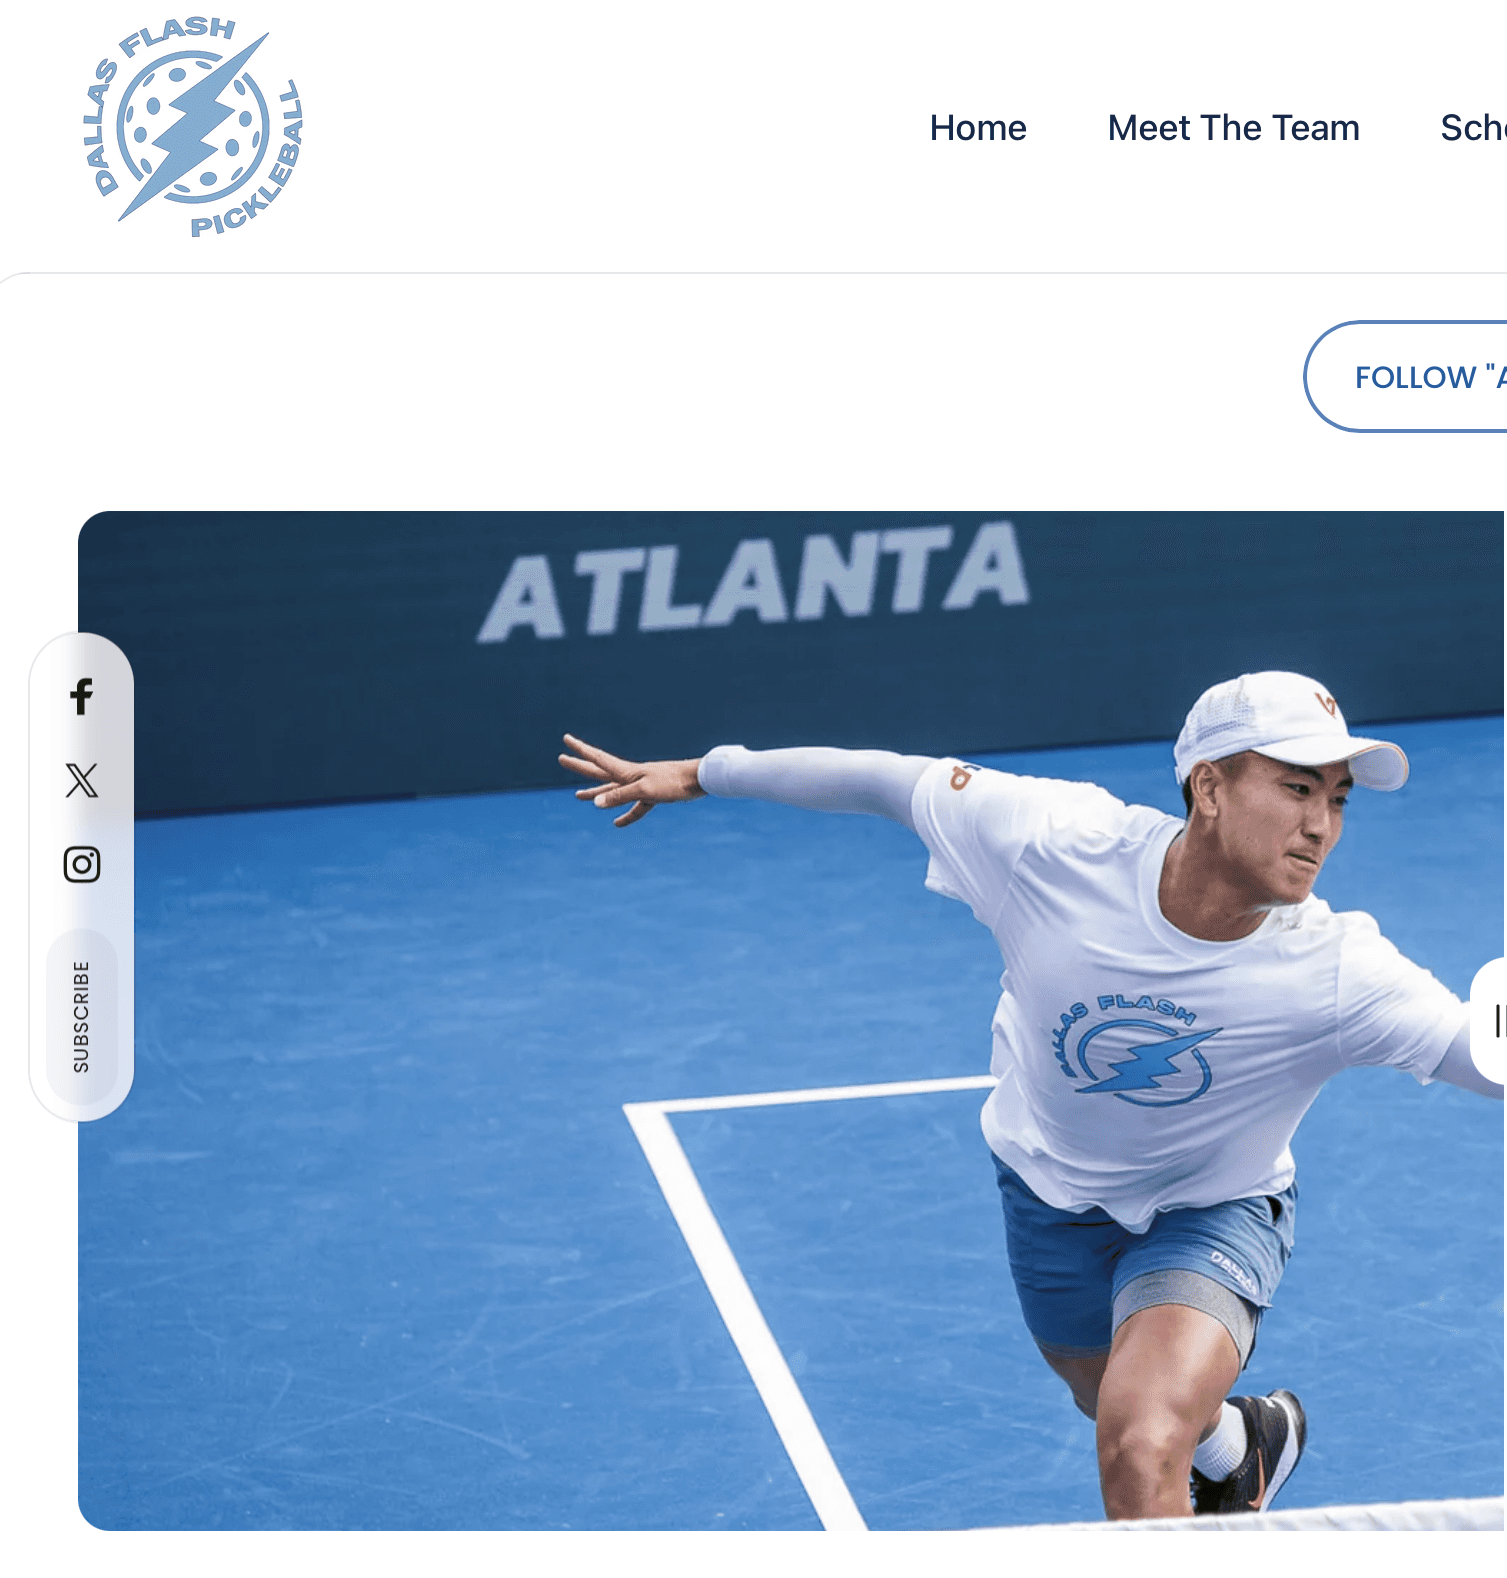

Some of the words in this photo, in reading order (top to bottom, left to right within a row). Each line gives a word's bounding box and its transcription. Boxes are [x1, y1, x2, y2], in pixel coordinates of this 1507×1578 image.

[83, 58, 119, 197] DALLAS
[118, 16, 236, 58] FLASH
[932, 114, 1026, 141] Home
[1110, 114, 1190, 141] Meet
[1200, 113, 1261, 141] The
[1272, 114, 1359, 141] Team
[191, 79, 303, 237] PICKLEBALL
[1356, 365, 1478, 389] FOLLOW
[476, 519, 1030, 643] ATLANTA
[73, 961, 90, 1073] SUBSCRIBE
[1052, 1002, 1088, 1078] DALLAS
[1097, 994, 1197, 1027] FLASH
